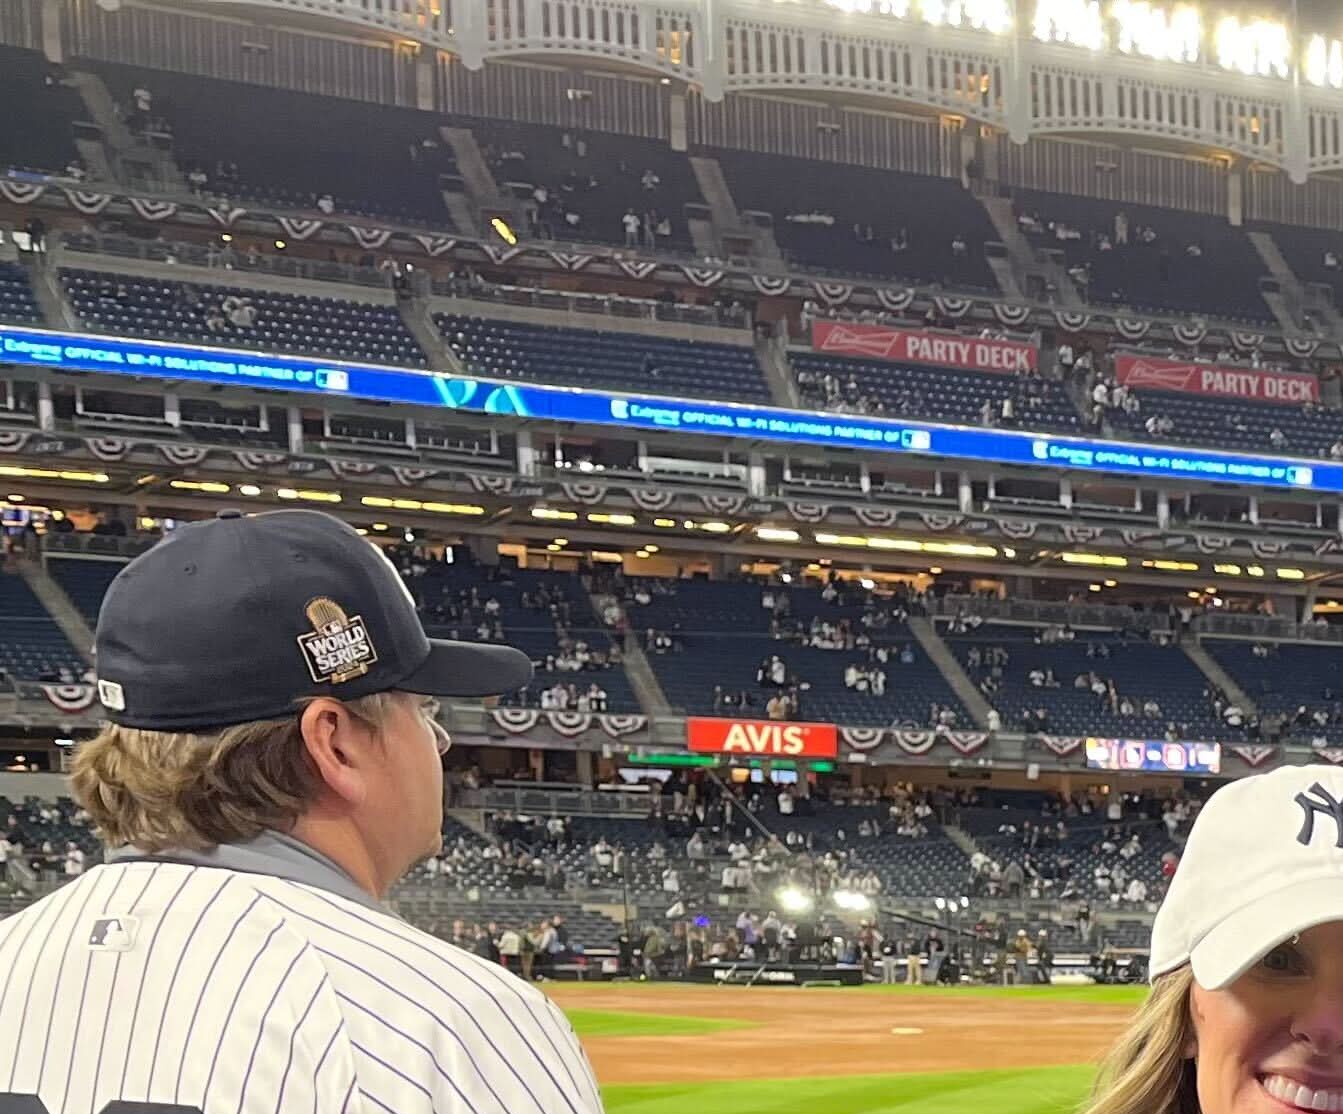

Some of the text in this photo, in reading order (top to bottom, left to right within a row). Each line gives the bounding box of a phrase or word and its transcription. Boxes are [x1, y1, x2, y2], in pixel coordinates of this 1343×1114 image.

[906, 336, 970, 364] PARTY
[976, 345, 1030, 370] DECK
[1202, 371, 1259, 397] PARTY
[1264, 378, 1312, 400] DECK
[305, 626, 364, 655] WORLD
[316, 641, 370, 671] SERIES
[723, 723, 805, 754] AVIS
